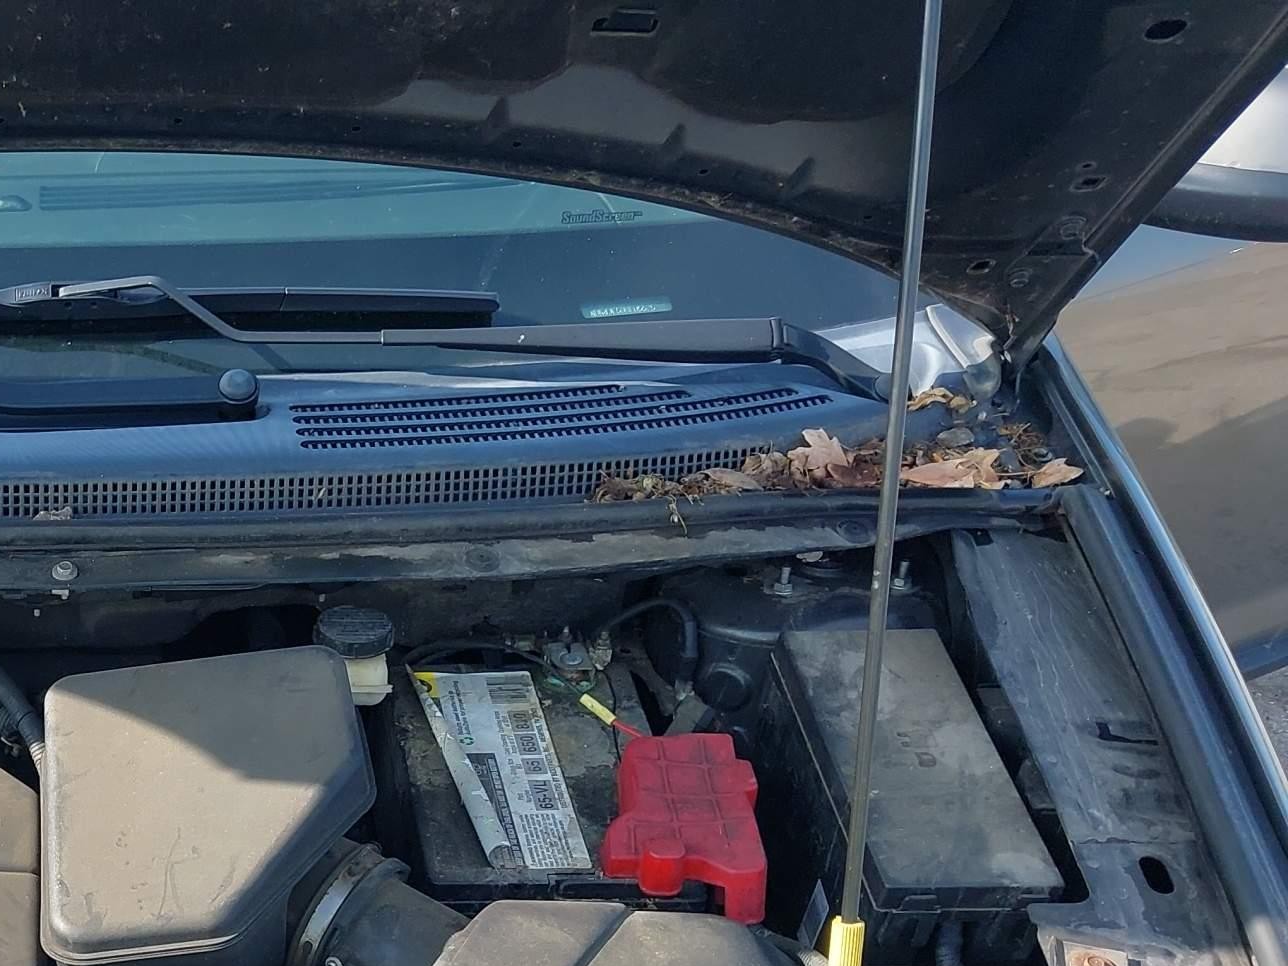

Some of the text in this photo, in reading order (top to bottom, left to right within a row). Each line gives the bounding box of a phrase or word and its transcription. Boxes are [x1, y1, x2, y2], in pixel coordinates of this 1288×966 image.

[520, 736, 537, 752] 650
[527, 760, 542, 772] 65
[534, 781, 554, 809] 65-VL
